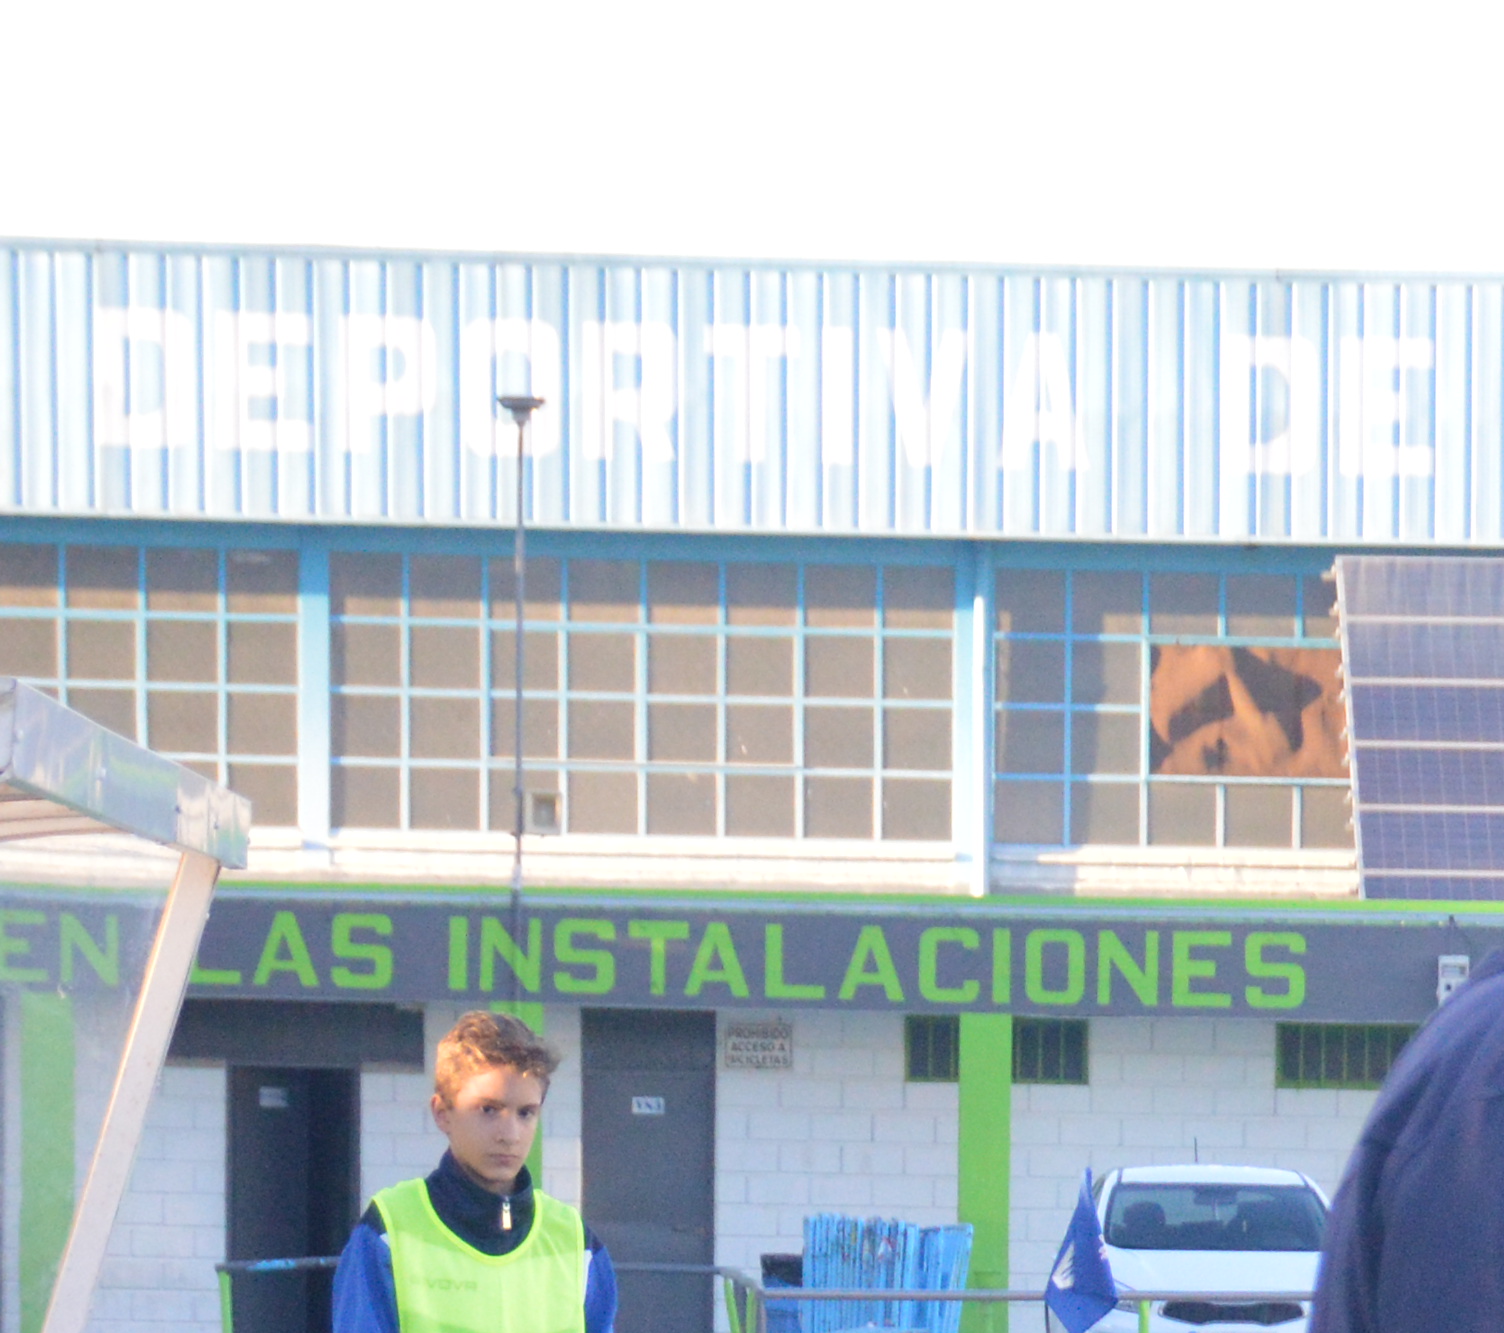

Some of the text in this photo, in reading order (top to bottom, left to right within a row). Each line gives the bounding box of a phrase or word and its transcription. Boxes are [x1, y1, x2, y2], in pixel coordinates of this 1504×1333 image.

[95, 306, 1091, 473] DEPORTIVA
[1223, 334, 1434, 478] DE
[447, 915, 1308, 1010] INSTALACIONES
